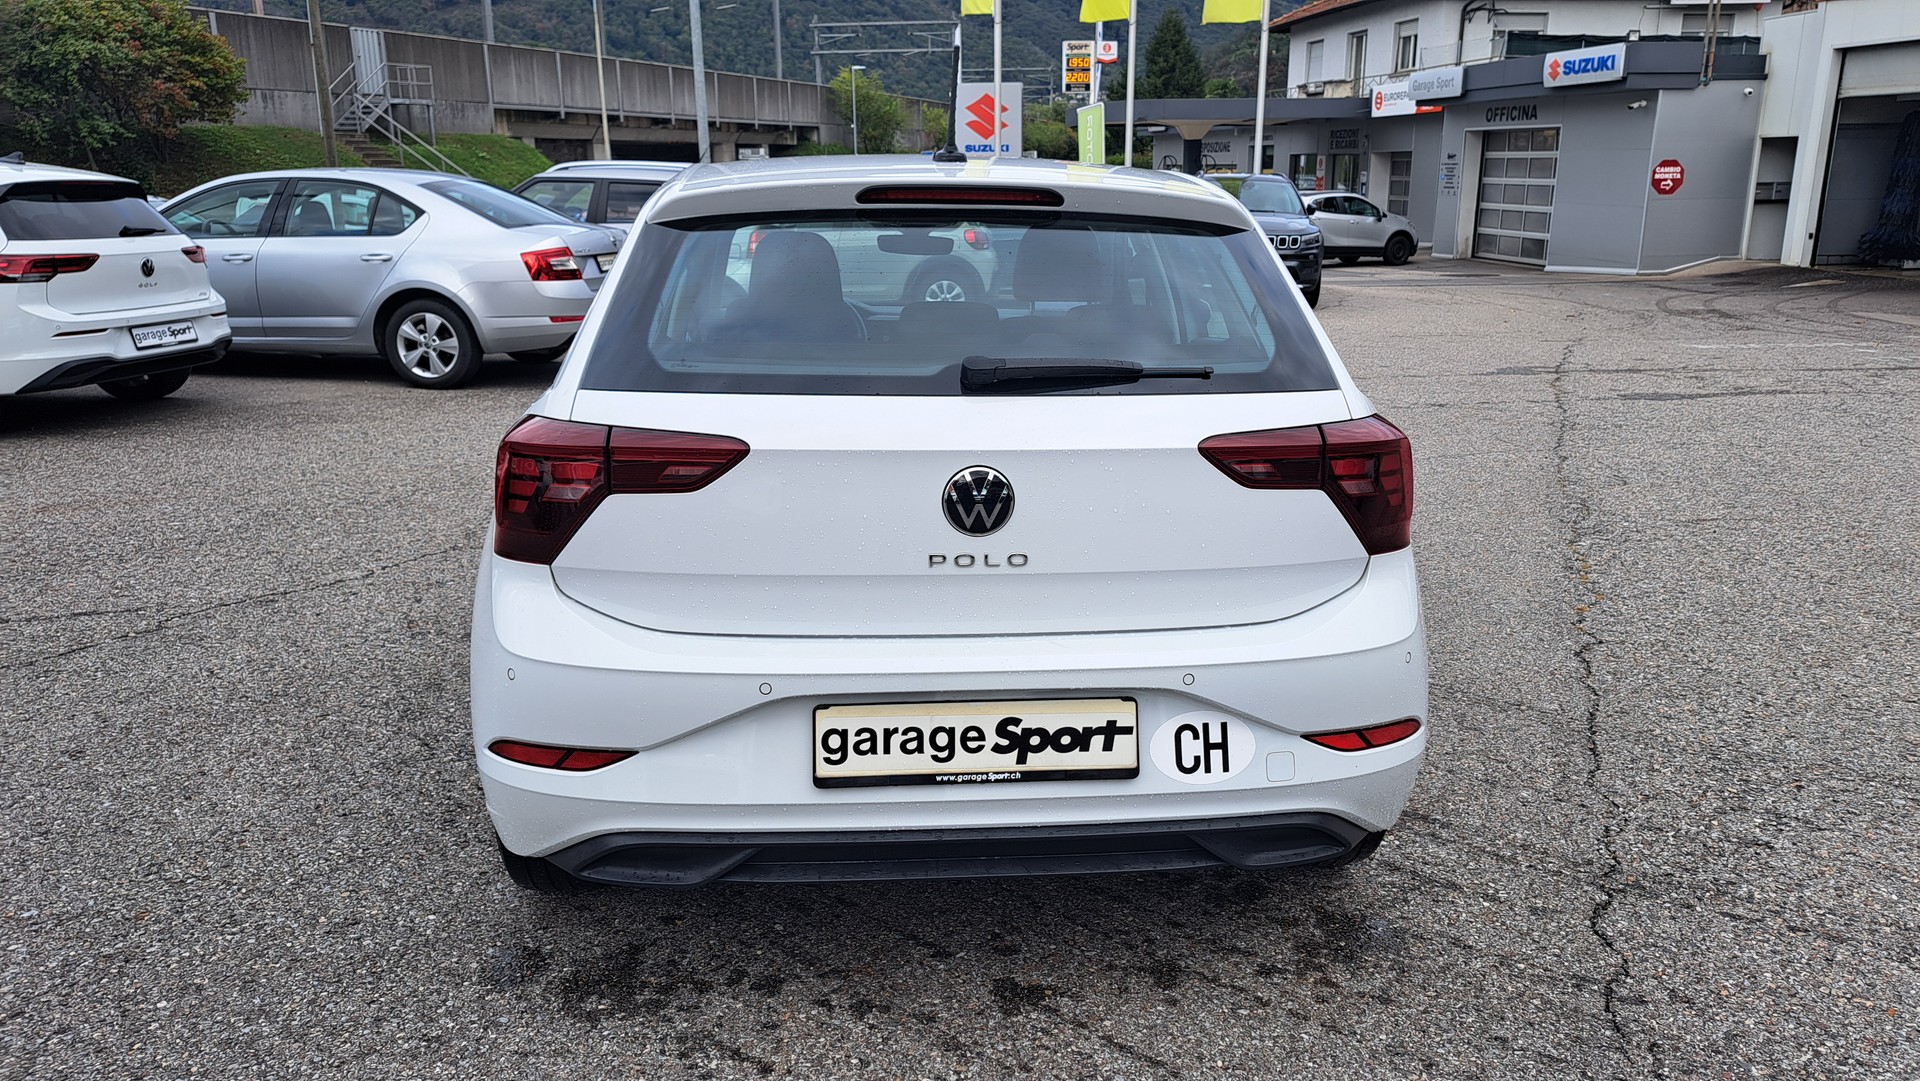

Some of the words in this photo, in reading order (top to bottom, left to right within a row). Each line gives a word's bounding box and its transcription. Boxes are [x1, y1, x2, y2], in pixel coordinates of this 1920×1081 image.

[1067, 42, 1090, 53] Sport
[1562, 54, 1616, 76] SUZUKI
[1412, 79, 1435, 92] Garage
[1436, 76, 1455, 91] Sport
[1485, 104, 1538, 122] OFFICINA
[928, 552, 1029, 568] POLO
[820, 724, 985, 767] garage
[989, 715, 1134, 765] Sport
[1173, 721, 1231, 775] CH
